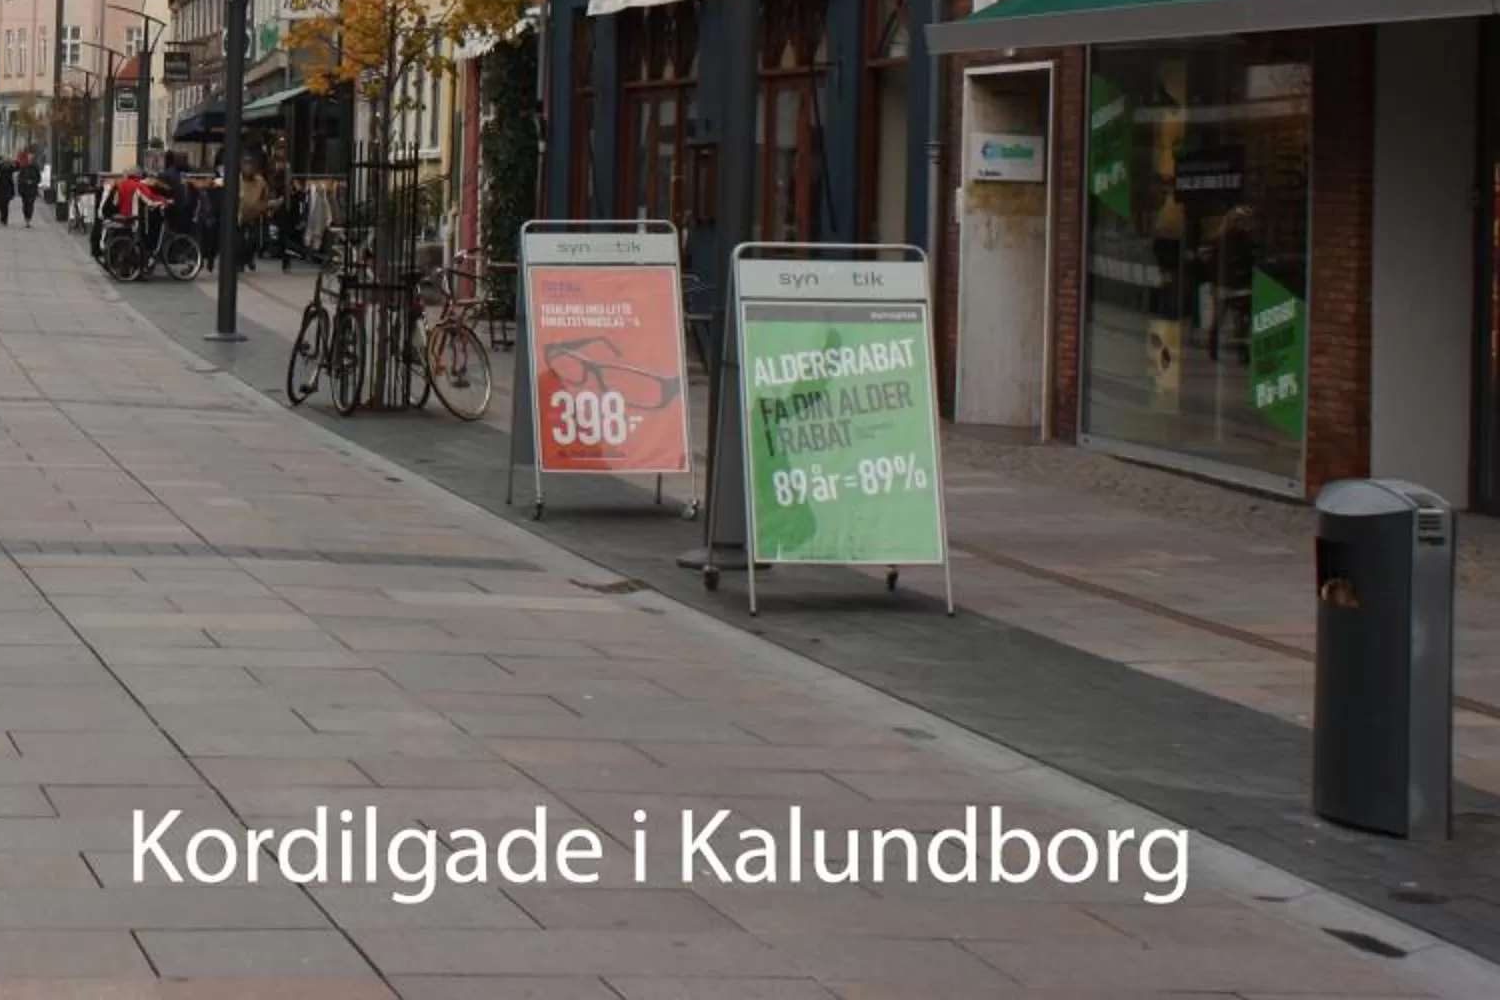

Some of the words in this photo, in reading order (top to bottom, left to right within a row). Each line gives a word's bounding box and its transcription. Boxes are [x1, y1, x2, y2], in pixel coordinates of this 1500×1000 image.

[753, 338, 915, 388] ALDERSRABAT
[792, 389, 834, 422] DIN
[839, 378, 914, 418] ALDER
[778, 418, 854, 457] RABAT
[772, 467, 808, 507] 89
